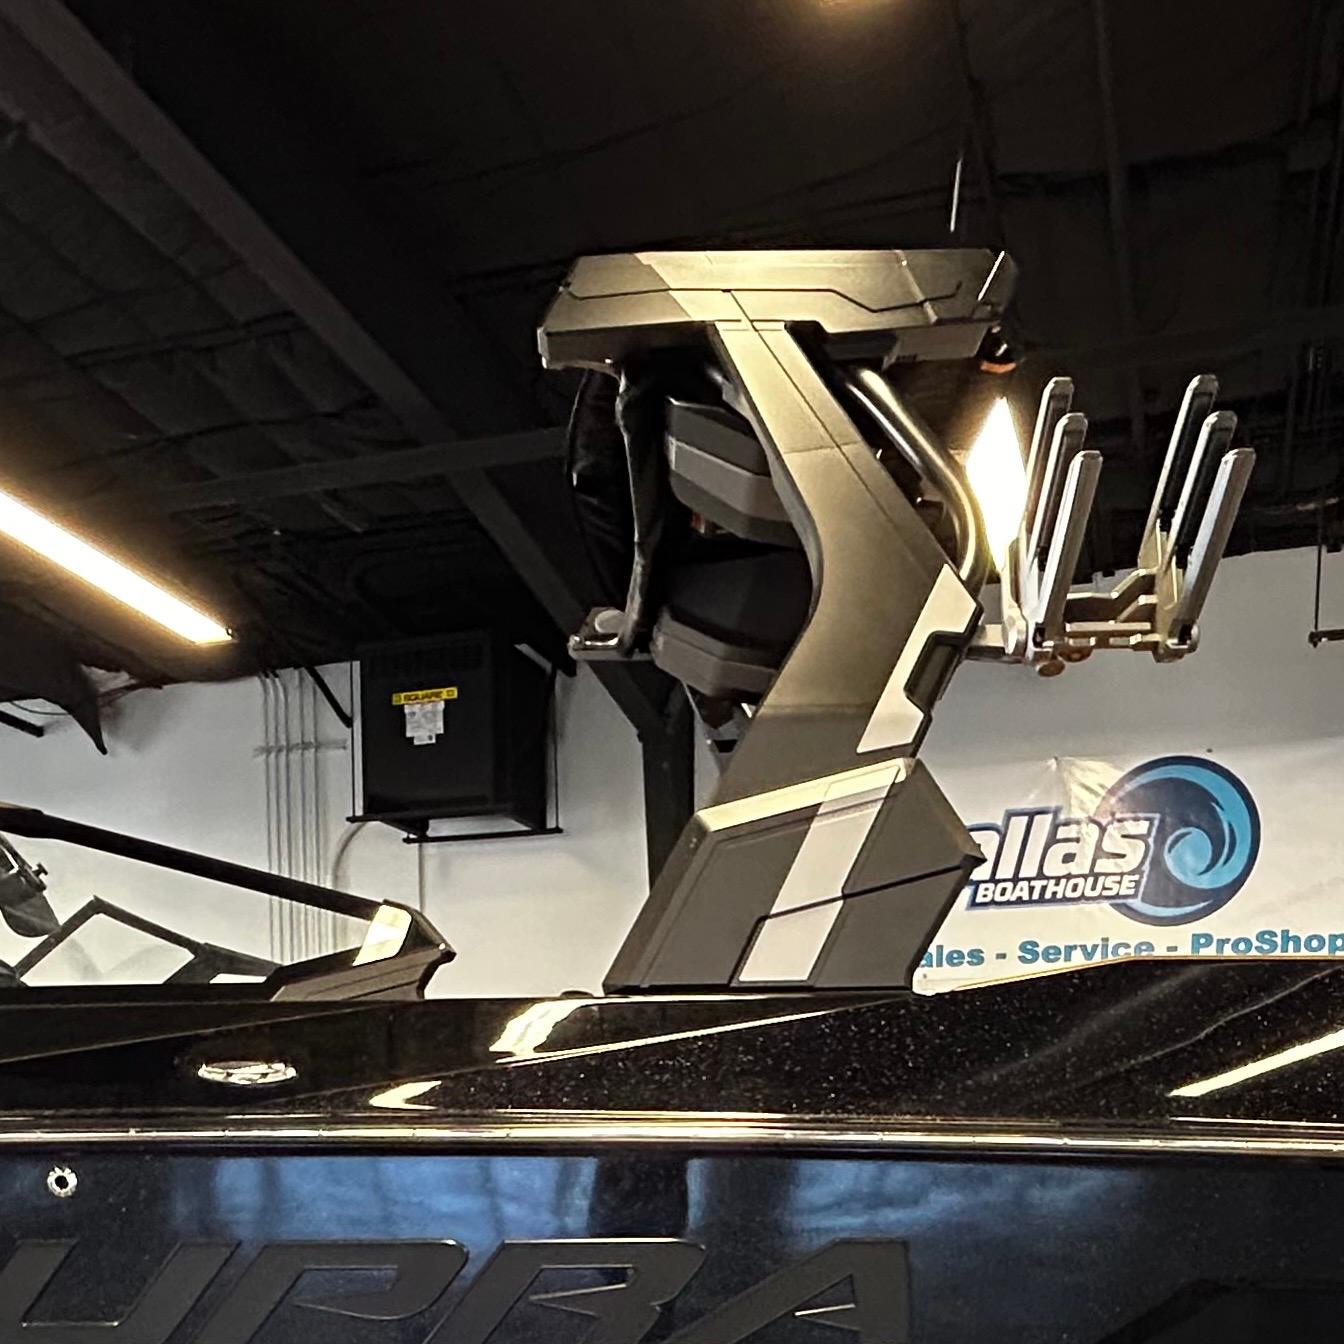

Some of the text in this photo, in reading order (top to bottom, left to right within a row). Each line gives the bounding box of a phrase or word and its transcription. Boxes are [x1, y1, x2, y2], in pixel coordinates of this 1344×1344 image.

[970, 814, 1151, 881] allas
[975, 874, 1139, 903] BOATHOUSE
[1017, 937, 1155, 964] Service
